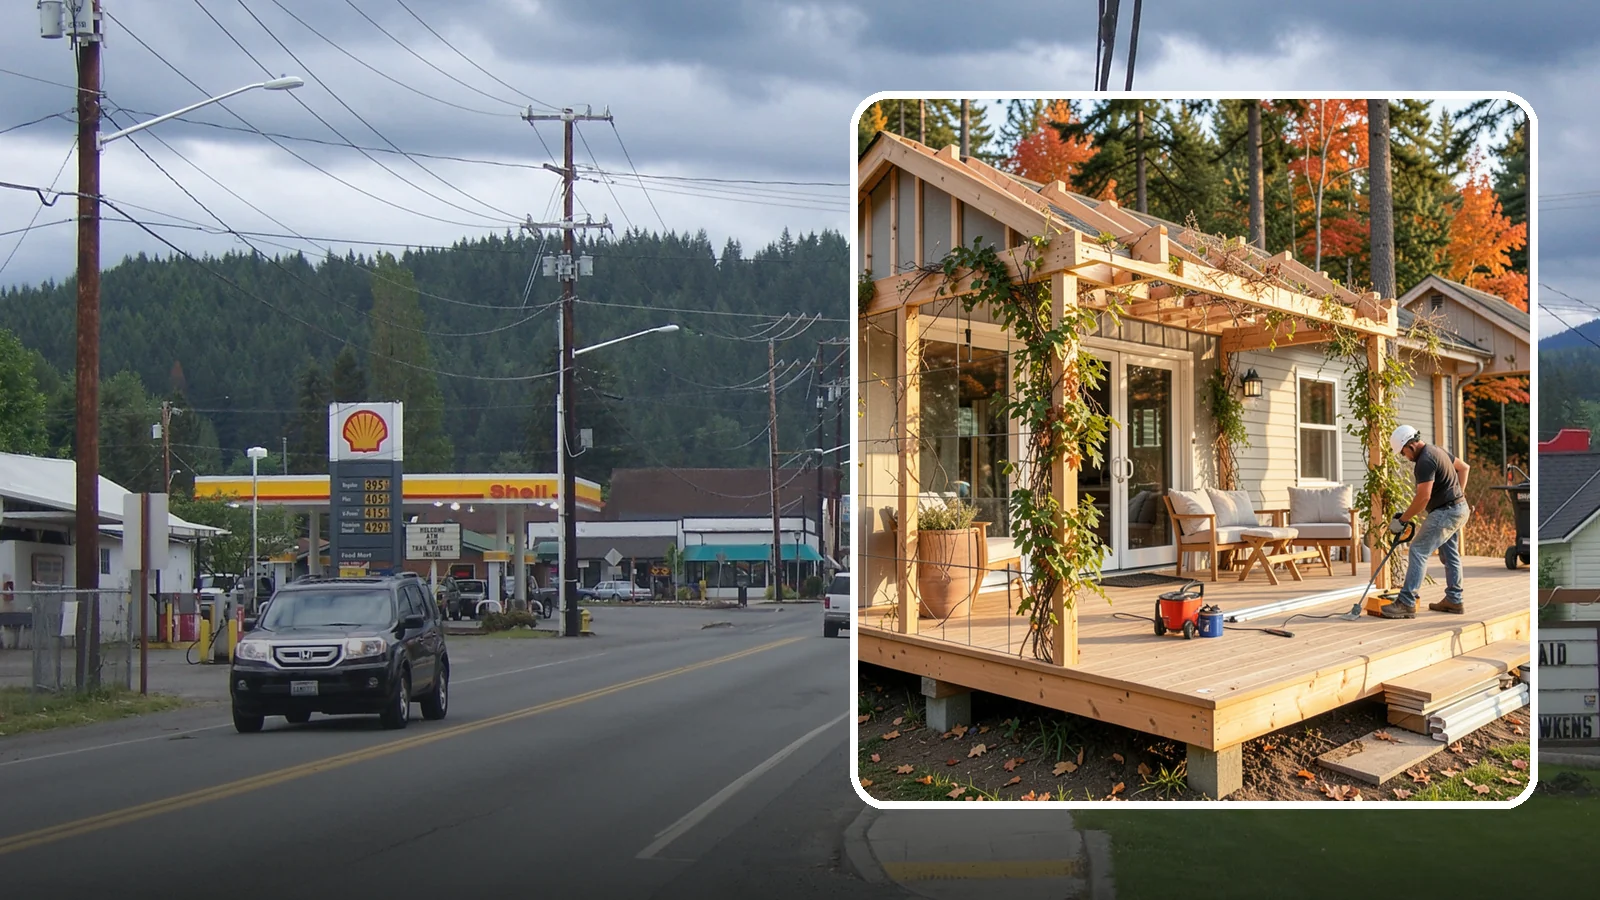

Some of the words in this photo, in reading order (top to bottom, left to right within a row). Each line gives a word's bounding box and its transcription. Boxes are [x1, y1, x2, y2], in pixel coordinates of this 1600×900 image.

[366, 480, 383, 490] 395
[490, 484, 547, 499] Shell
[366, 494, 383, 504] 405
[366, 508, 383, 518] 415
[366, 522, 383, 533] 429
[1538, 643, 1566, 665] AID
